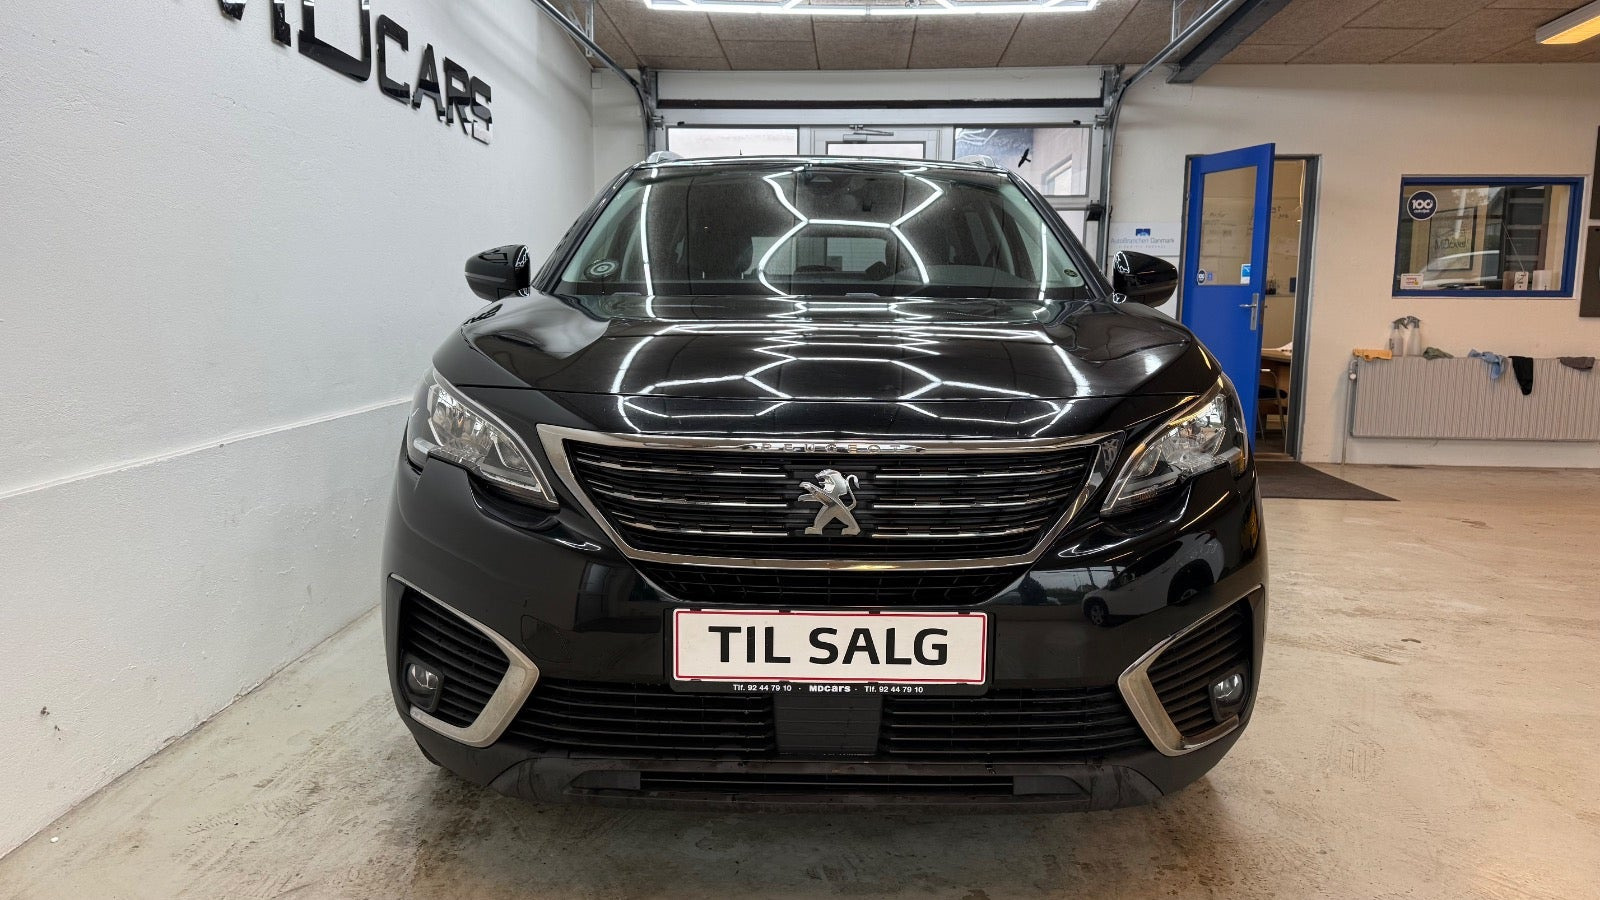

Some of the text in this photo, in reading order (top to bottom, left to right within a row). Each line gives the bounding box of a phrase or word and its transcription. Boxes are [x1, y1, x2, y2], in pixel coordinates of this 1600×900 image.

[761, 443, 901, 453] PEUGEOT
[708, 626, 948, 666] TIL SALG
[771, 684, 781, 692] 79
[809, 685, 851, 693] MDcars
